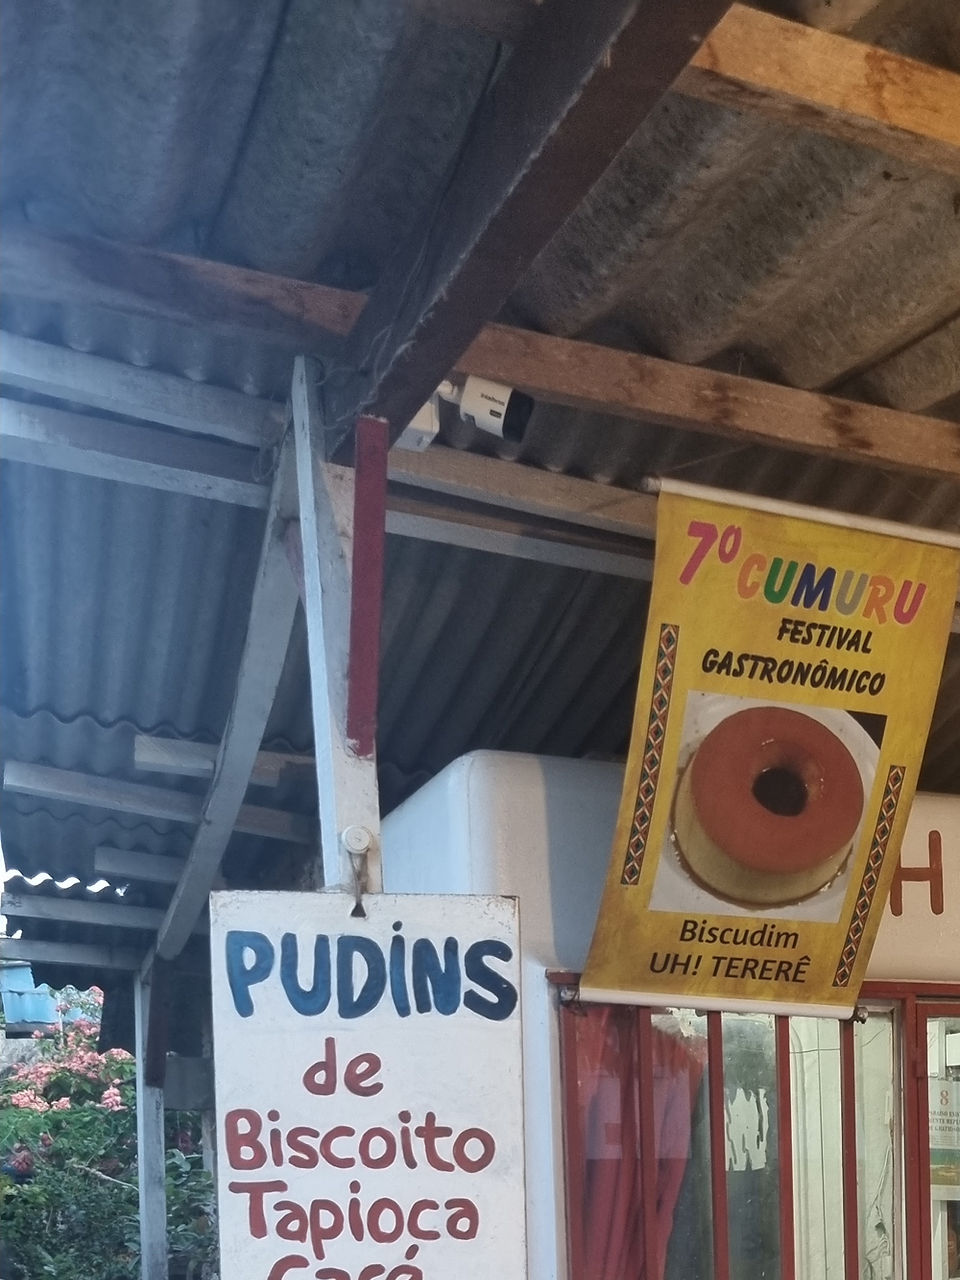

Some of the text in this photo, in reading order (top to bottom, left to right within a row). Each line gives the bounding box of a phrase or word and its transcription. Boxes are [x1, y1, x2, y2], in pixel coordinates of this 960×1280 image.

[737, 553, 927, 625] CUMURU
[776, 617, 873, 655] FESTIVAL
[701, 648, 886, 696] GASTRONÔMICO
[679, 919, 799, 949] Biscudim
[650, 952, 811, 983] UH! TERERÊ
[302, 1037, 383, 1097] de
[224, 1109, 496, 1173] Biscoito
[228, 1180, 480, 1260] Tapioca
